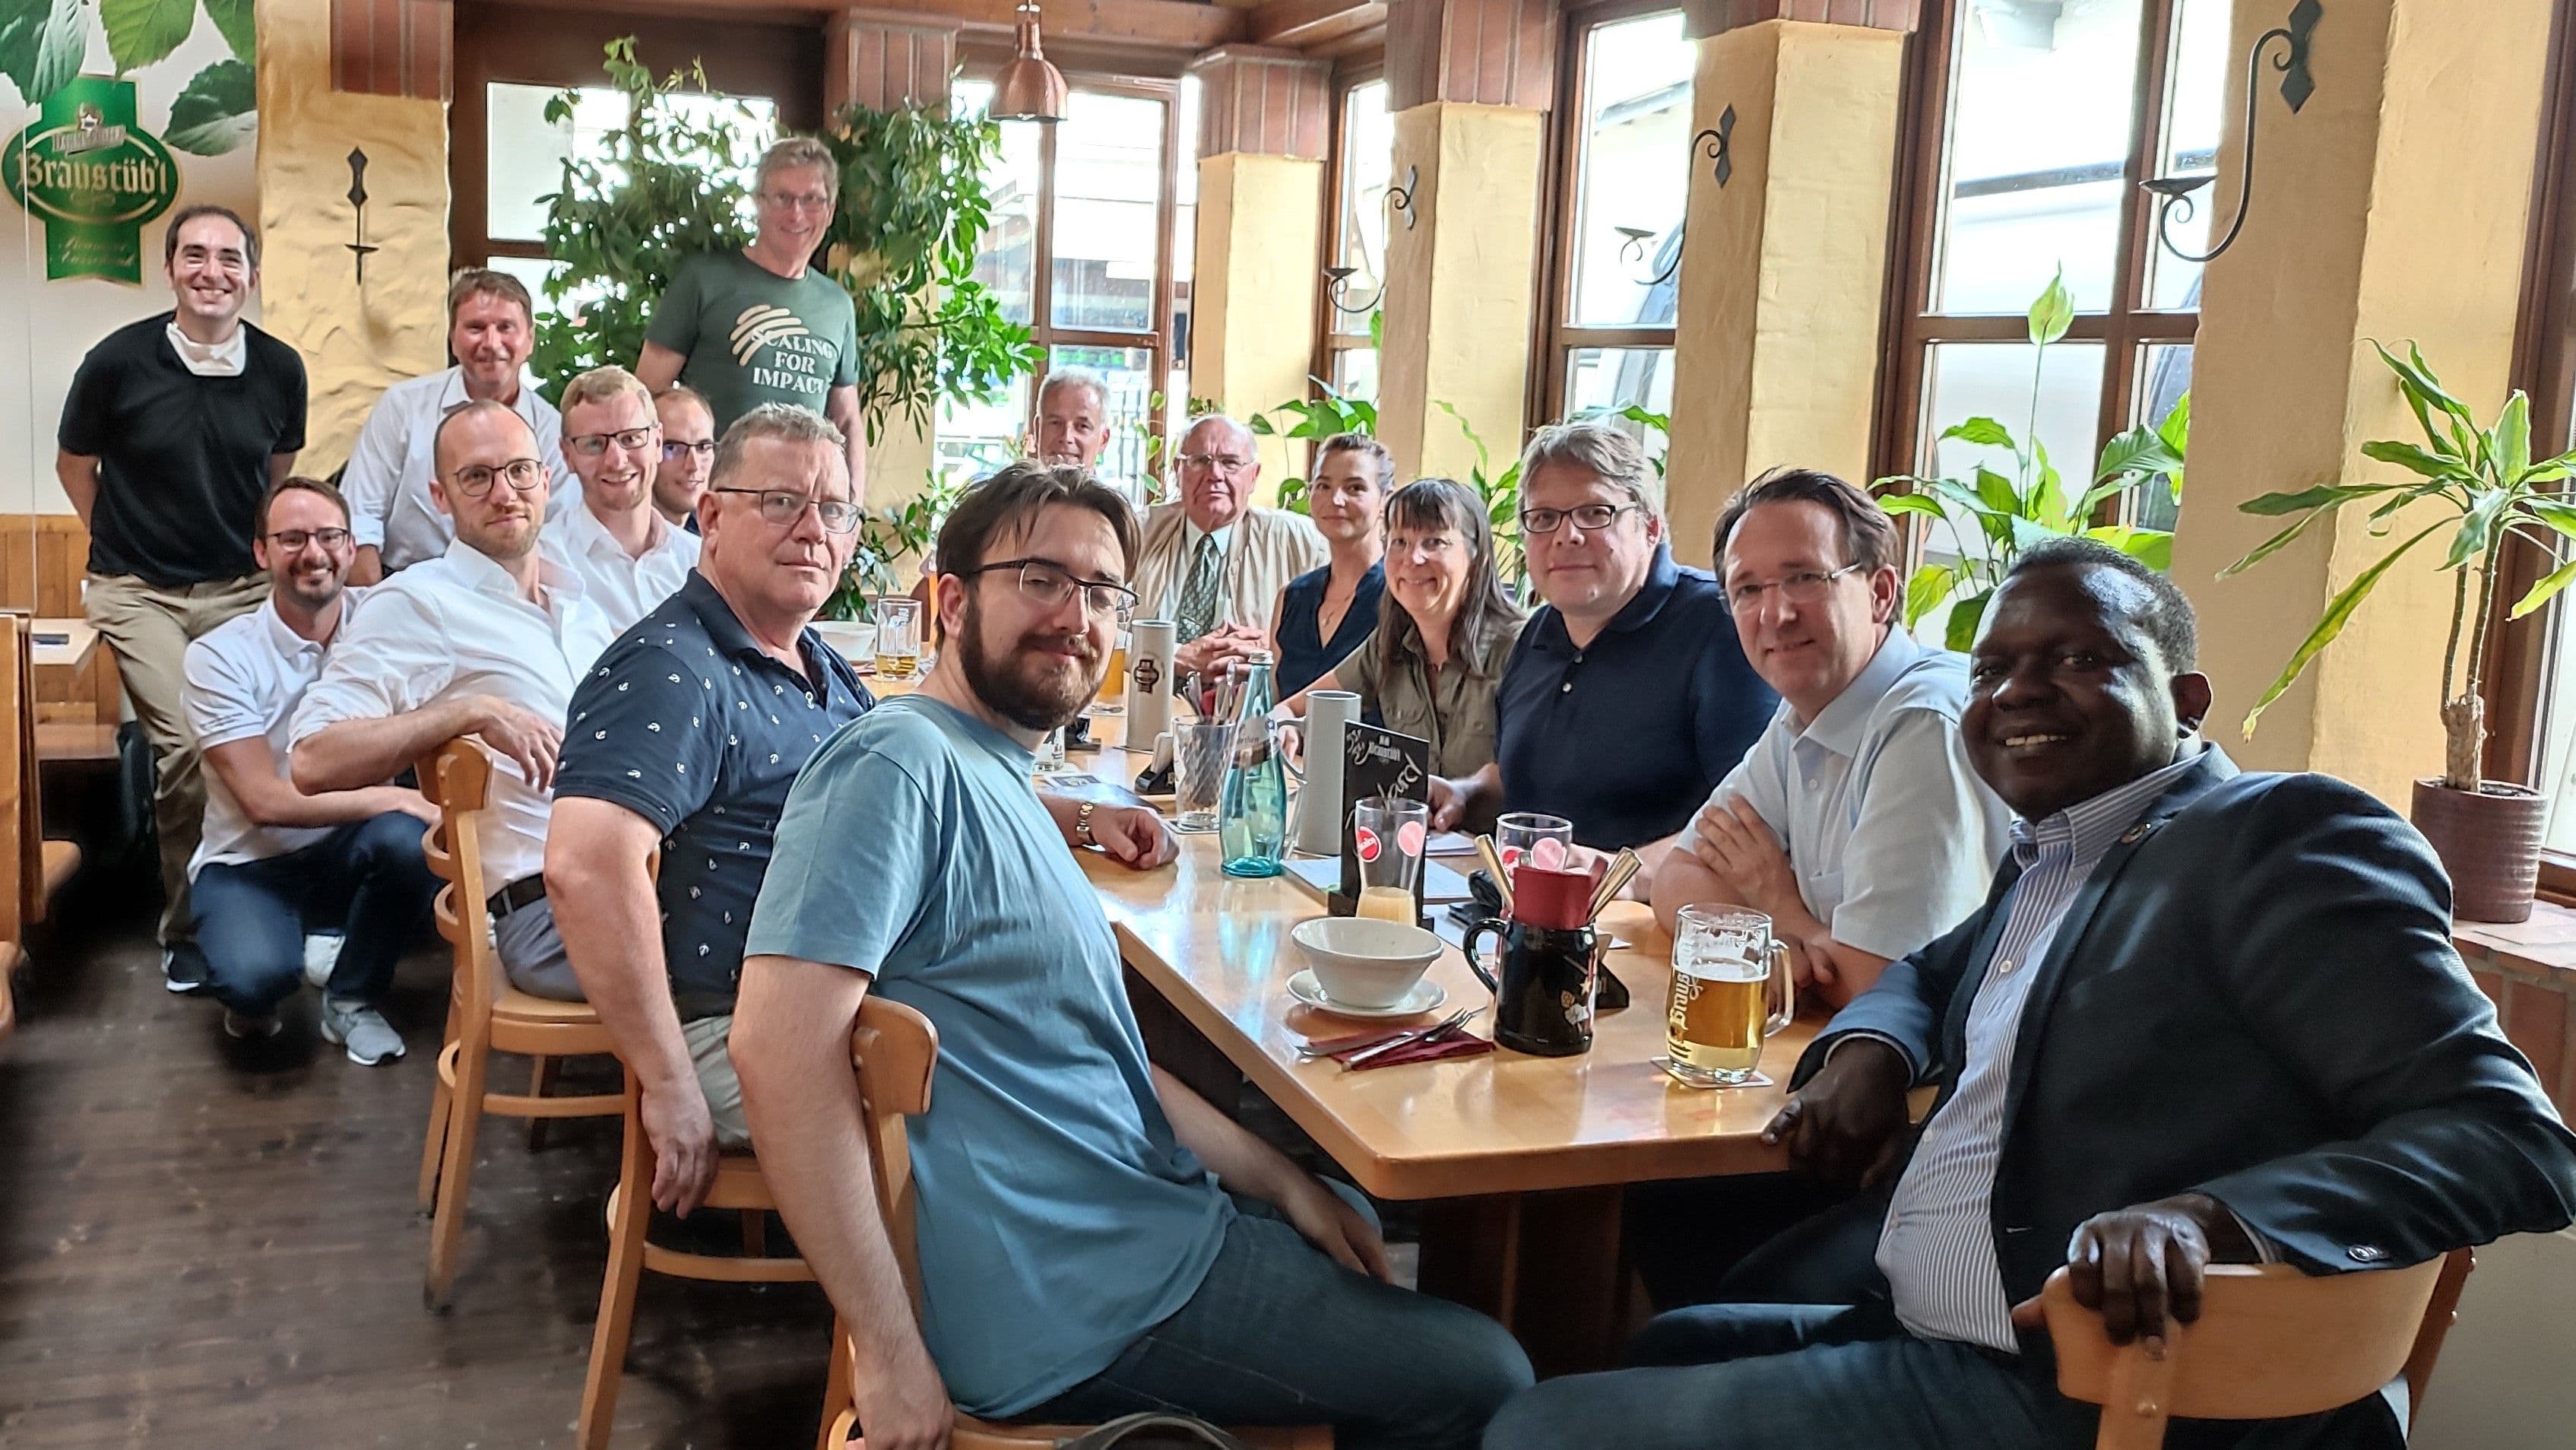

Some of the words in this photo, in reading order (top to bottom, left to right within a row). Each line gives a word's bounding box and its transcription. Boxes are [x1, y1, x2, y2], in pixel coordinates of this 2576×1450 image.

[751, 328, 834, 360] SCALING
[774, 351, 816, 375] FOR
[753, 366, 825, 395] IMPACT
